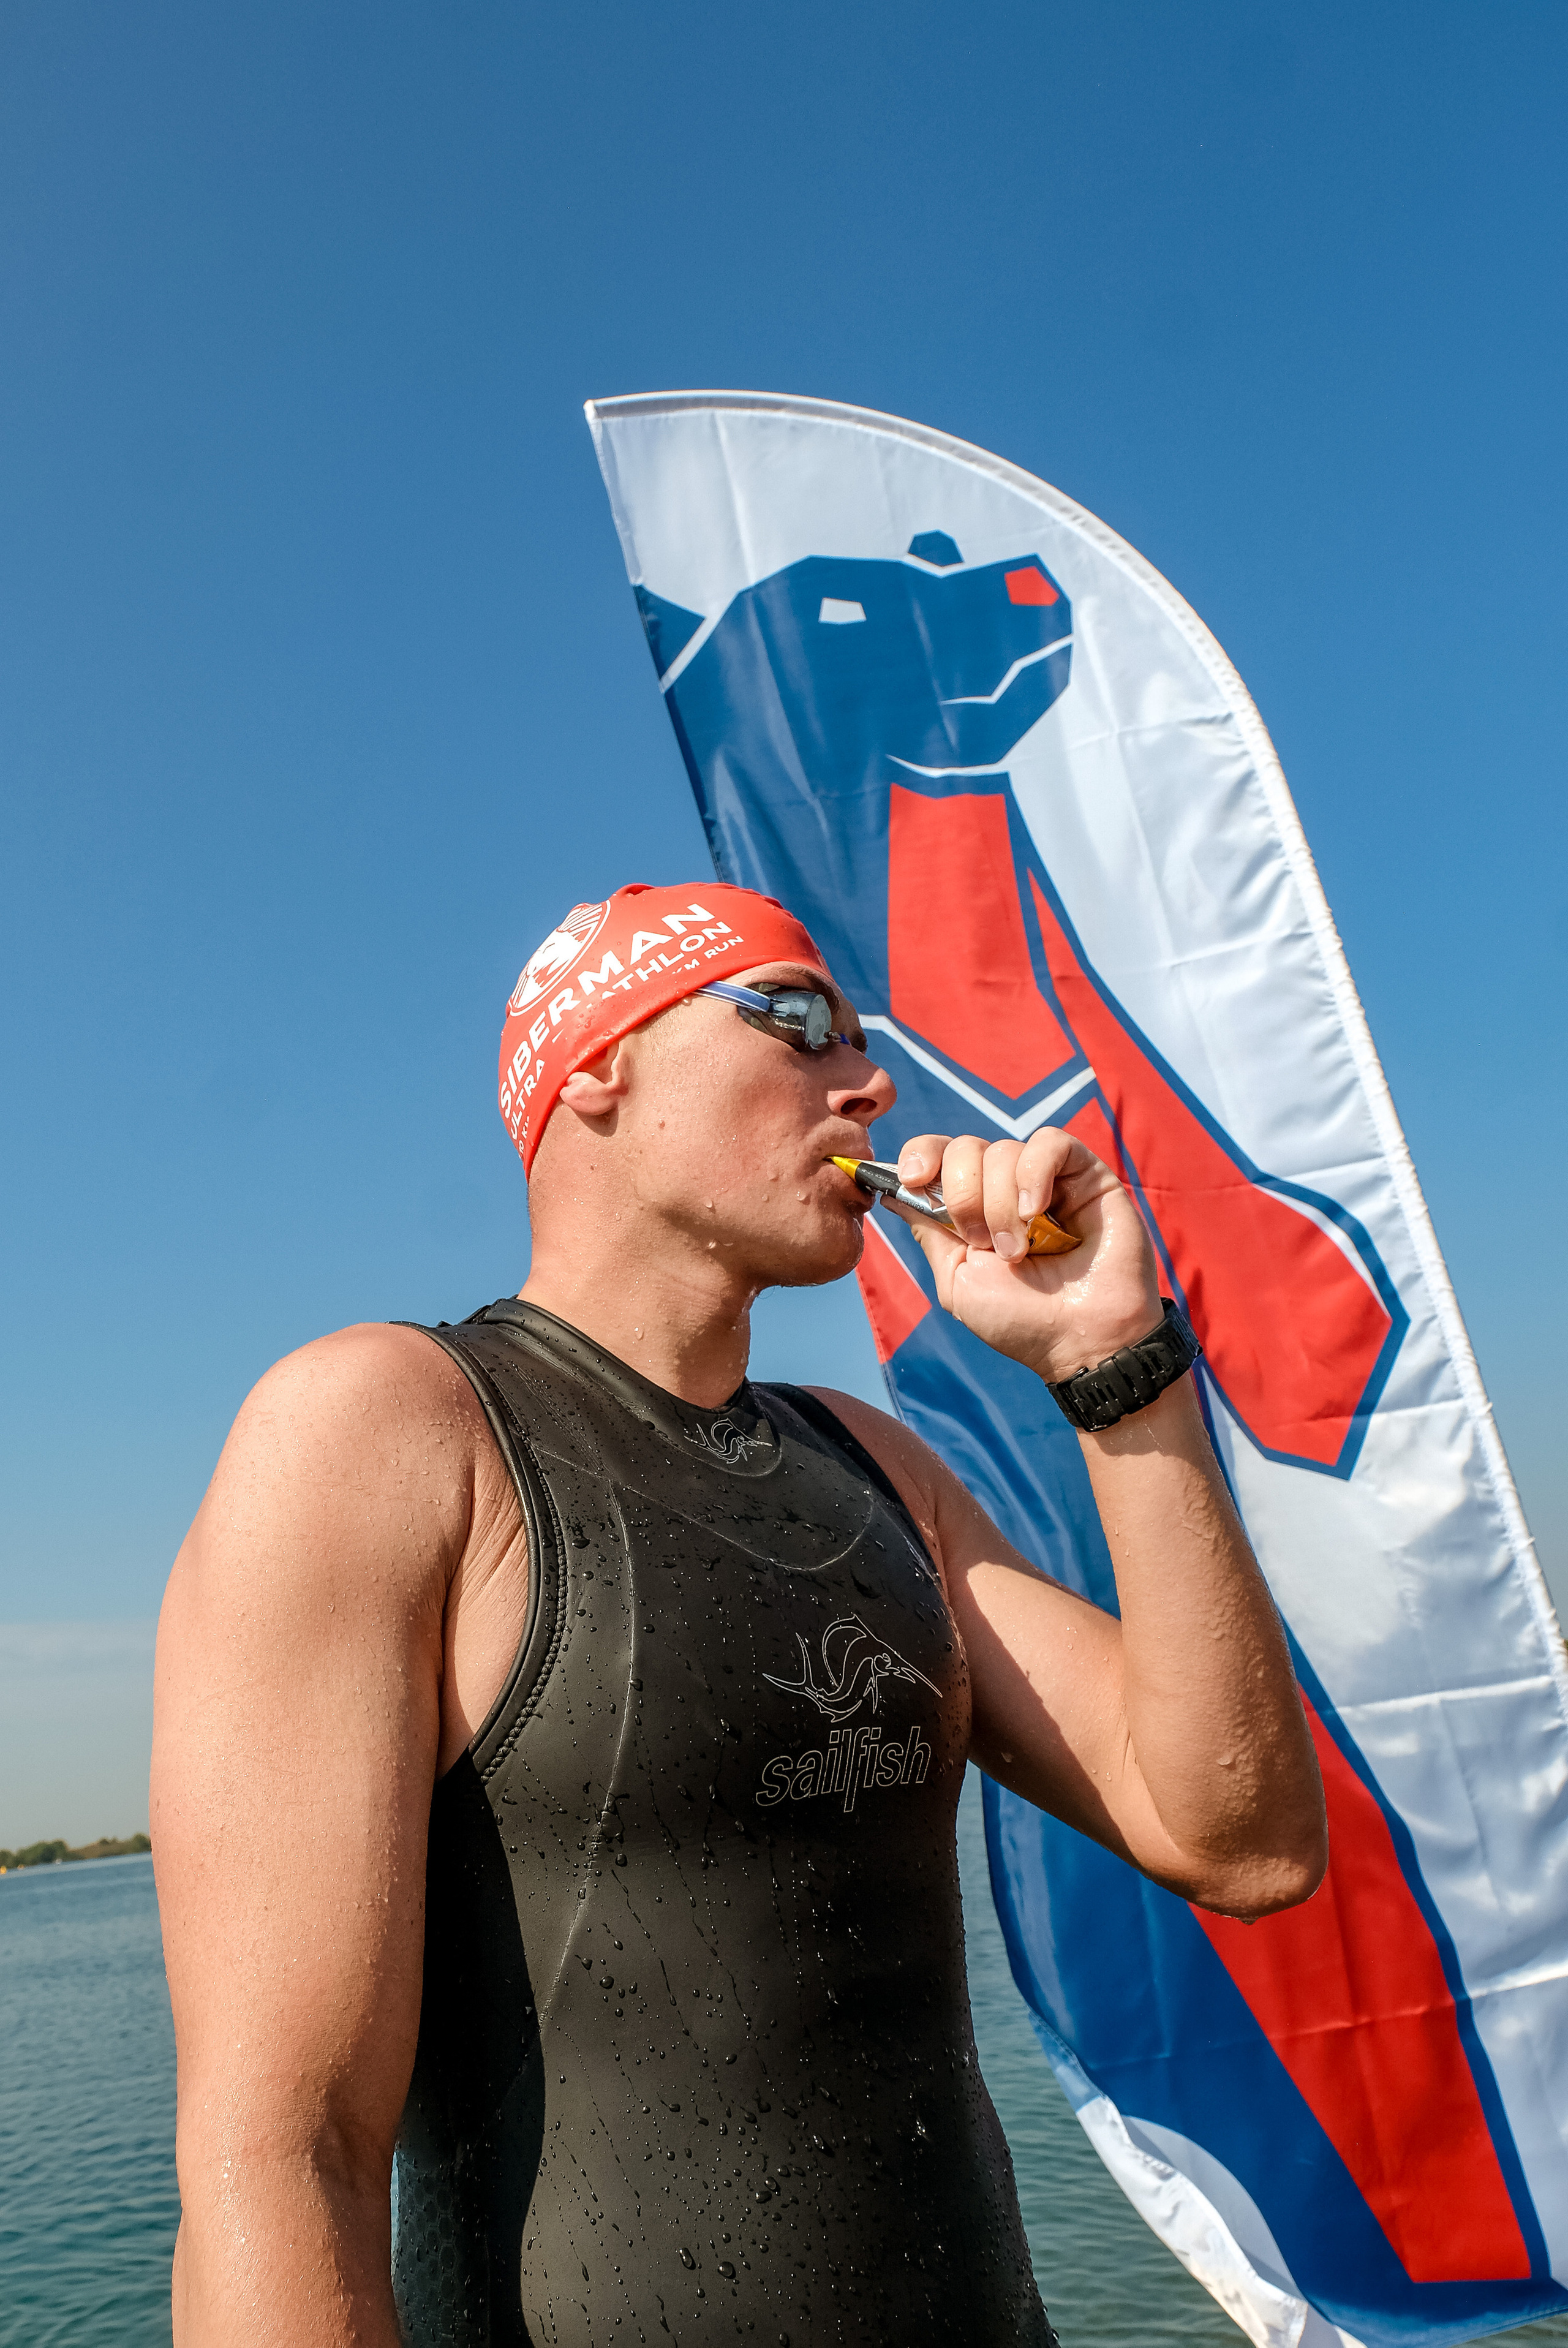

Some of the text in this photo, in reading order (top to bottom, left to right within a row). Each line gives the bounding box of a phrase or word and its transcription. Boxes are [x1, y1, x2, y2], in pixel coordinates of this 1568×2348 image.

[704, 936, 744, 959] RUN
[500, 904, 715, 1119] SIBERMAN
[511, 1059, 545, 1140] ULTRA
[755, 1726, 932, 1813] sailfish
